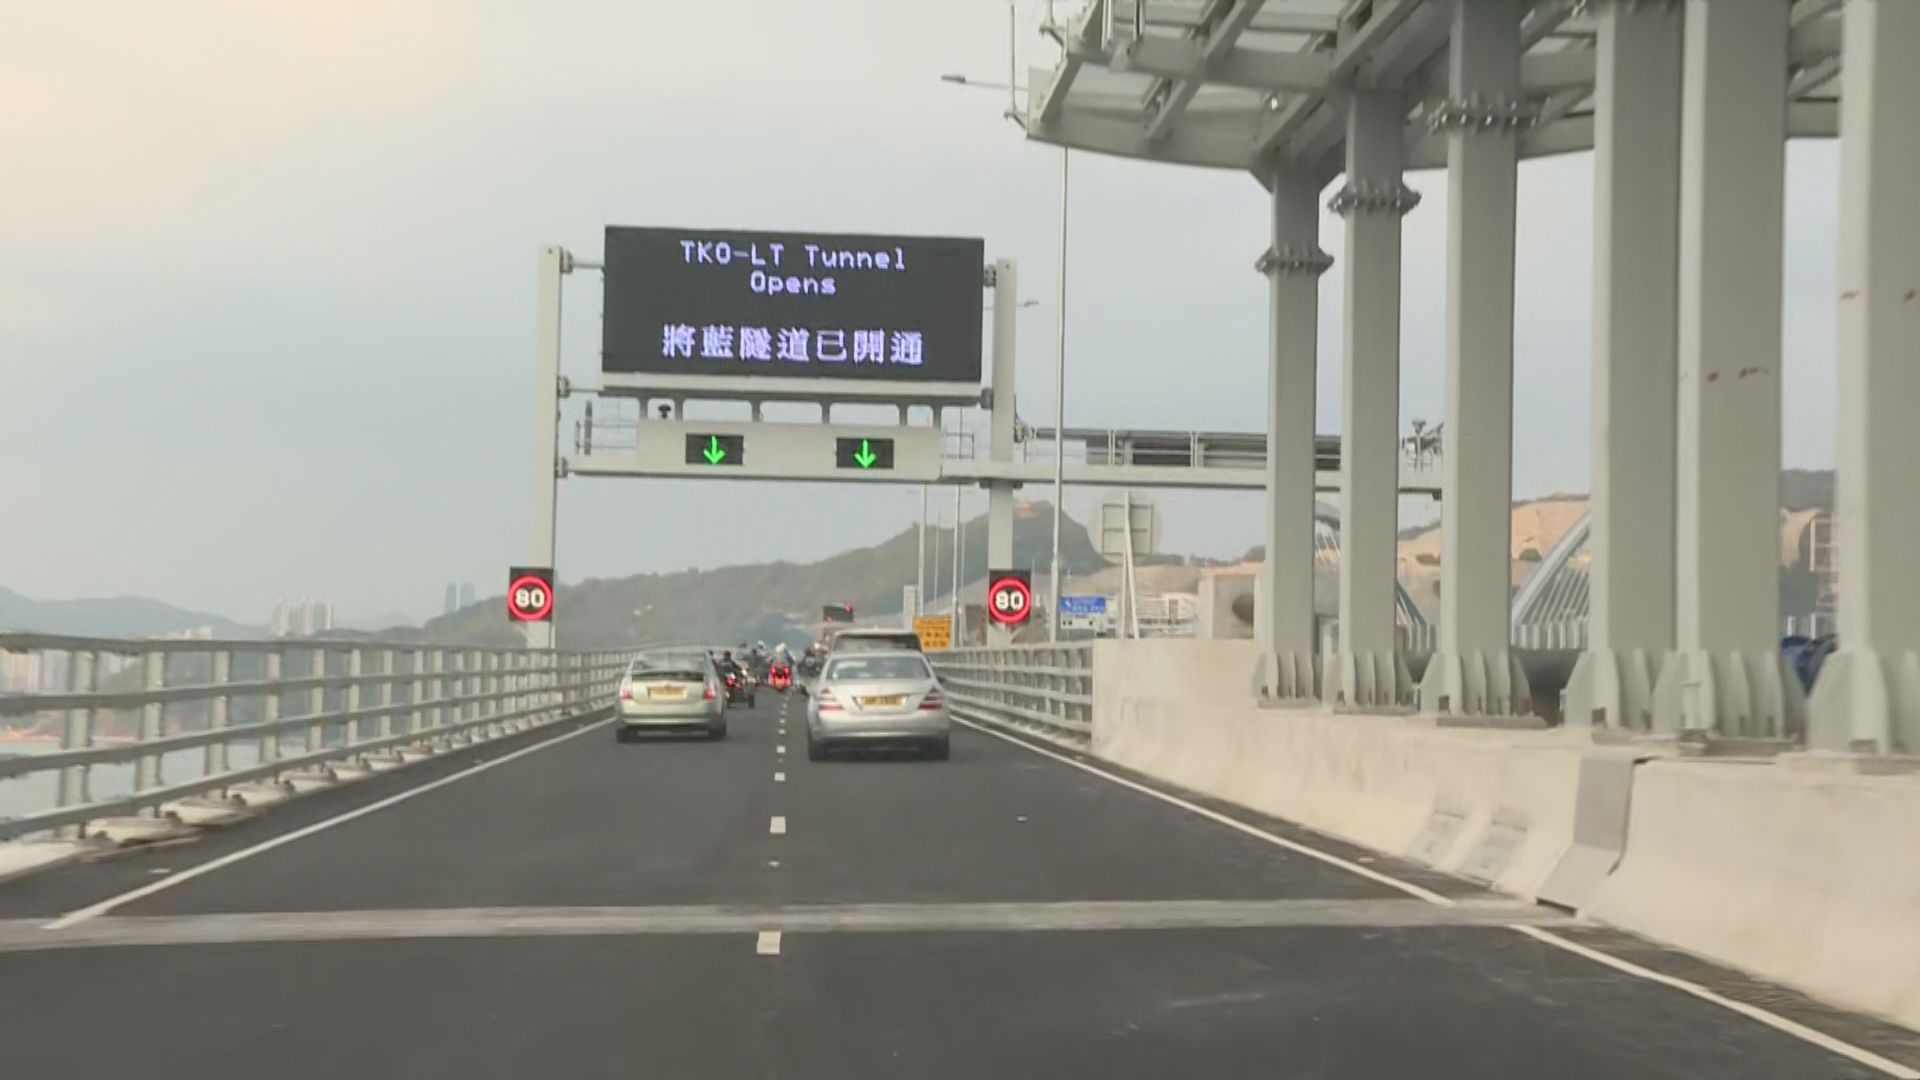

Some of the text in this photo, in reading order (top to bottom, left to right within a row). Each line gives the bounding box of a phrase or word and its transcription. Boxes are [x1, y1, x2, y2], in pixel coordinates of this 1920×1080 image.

[680, 240, 906, 271] TKO-LT Tunnel
[750, 271, 836, 296] Opens
[661, 323, 924, 366] 將藍隧道已開通
[515, 588, 545, 608] 80
[994, 590, 1024, 610] 80
